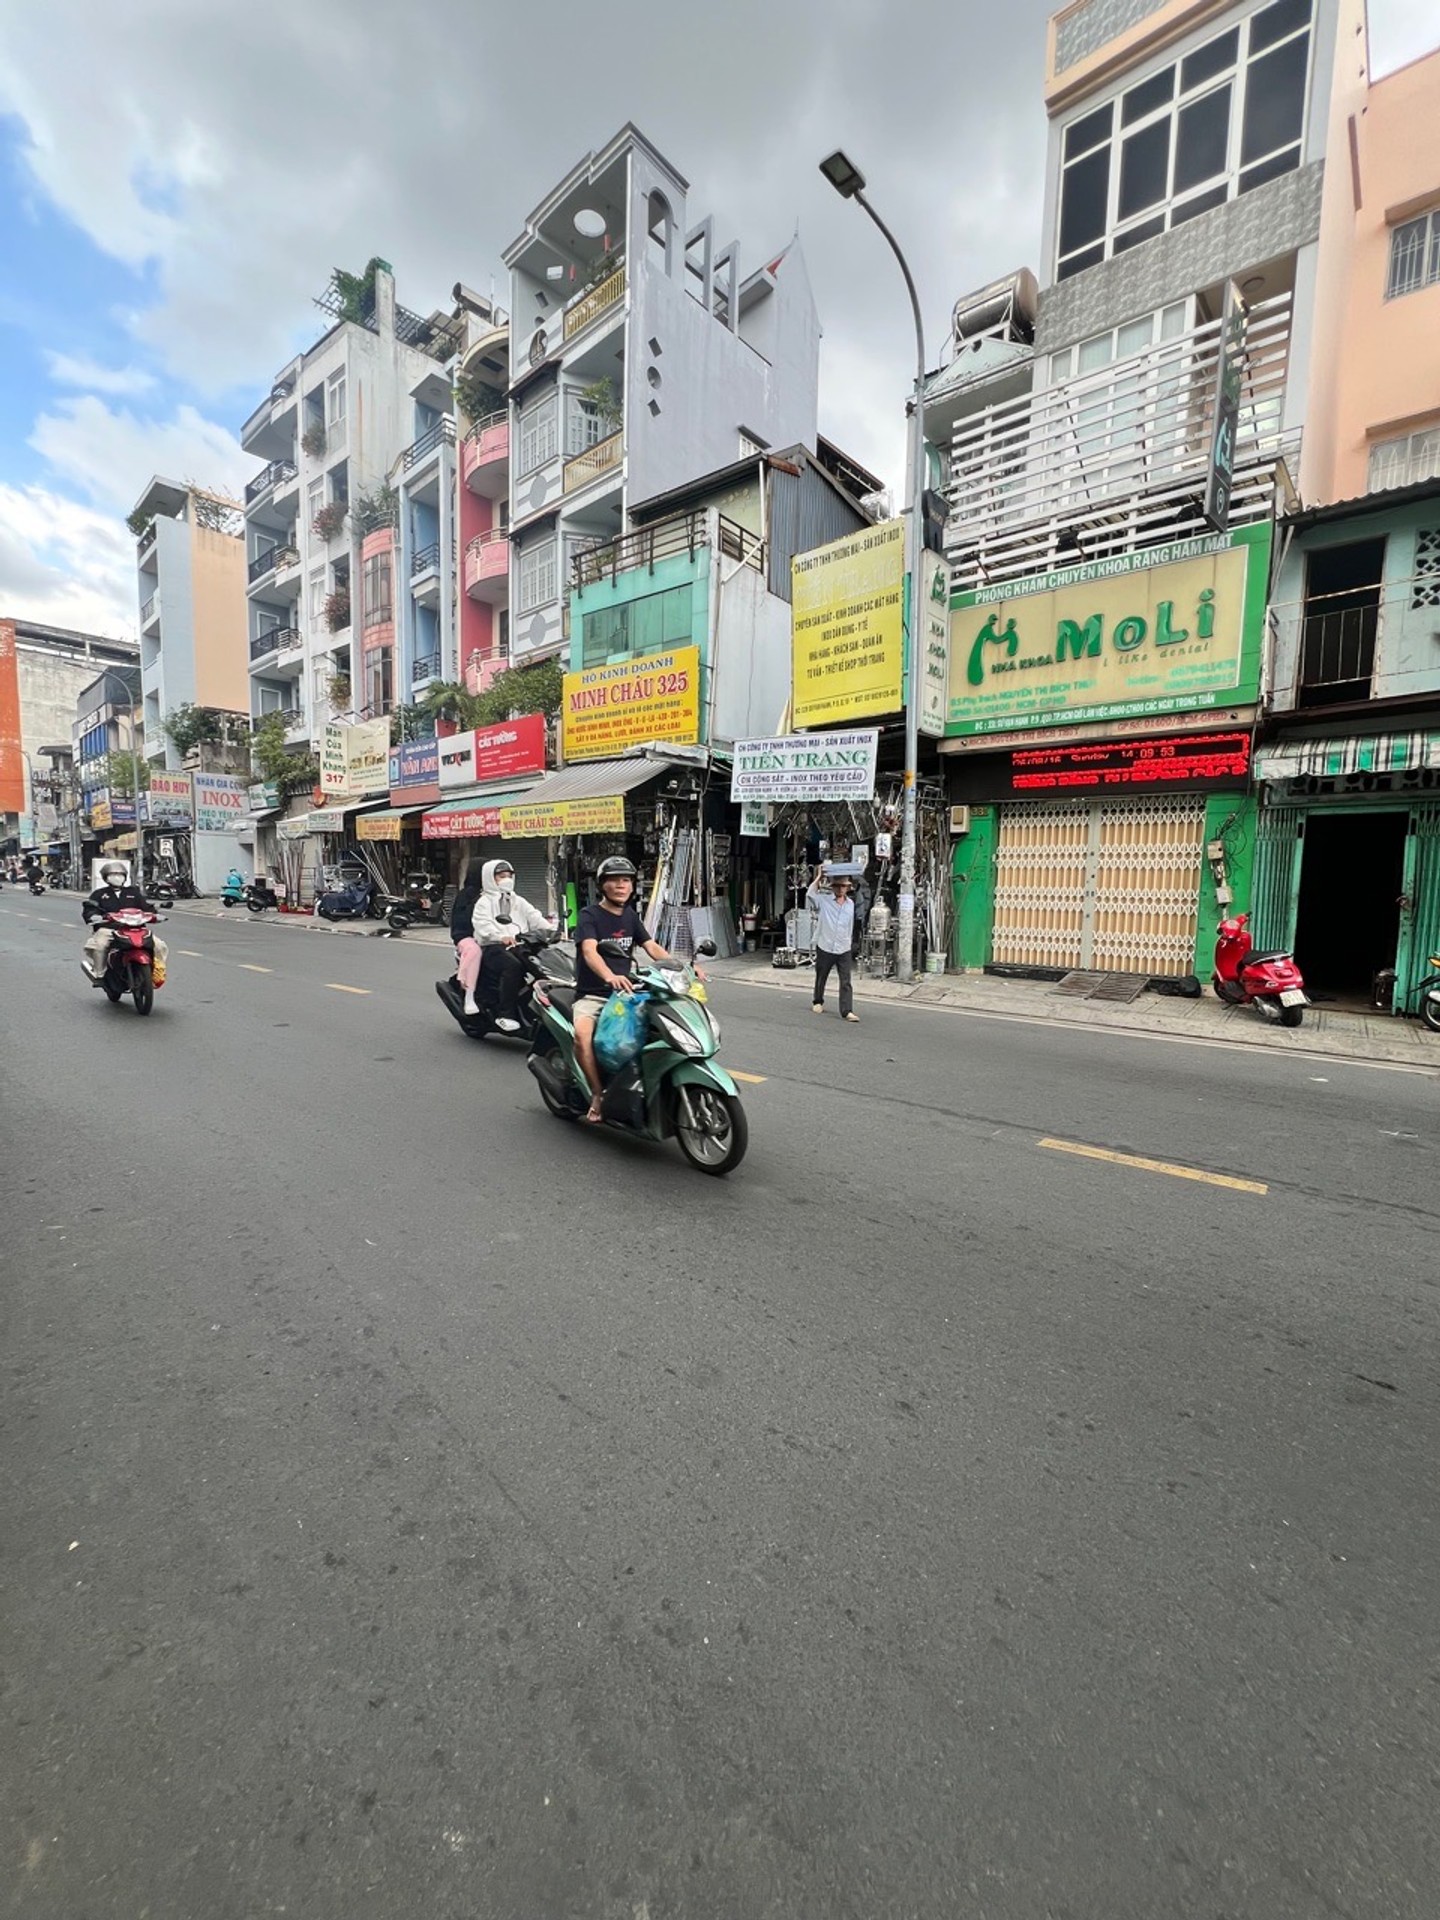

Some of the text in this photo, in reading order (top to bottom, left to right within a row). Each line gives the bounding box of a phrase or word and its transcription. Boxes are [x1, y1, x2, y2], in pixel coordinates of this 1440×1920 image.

[975, 583, 1012, 605] PHÒNG
[1013, 575, 1047, 596] KHÁM
[1049, 566, 1096, 588] CHUYÊN
[1096, 557, 1130, 577] KHOA
[1132, 547, 1170, 569] RĂNG
[1172, 538, 1202, 560] HÀM
[1159, 642, 1209, 658] dental
[600, 666, 628, 680] KINH
[632, 656, 673, 673] DOANH
[570, 687, 608, 711] MINH
[657, 670, 688, 696] 325
[1176, 696, 1197, 708] TRONG
[839, 734, 855, 745] XUẤT
[856, 735, 873, 744] INOX
[740, 750, 870, 770] TIẾN TRANG
[323, 761, 346, 775] Khang
[216, 778, 227, 788] GIA
[326, 773, 344, 784] 317
[790, 774, 808, 782] INOX
[810, 773, 828, 782] THEO
[173, 780, 190, 794] HUY
[202, 791, 242, 808] INOX
[197, 809, 216, 818] THEO
